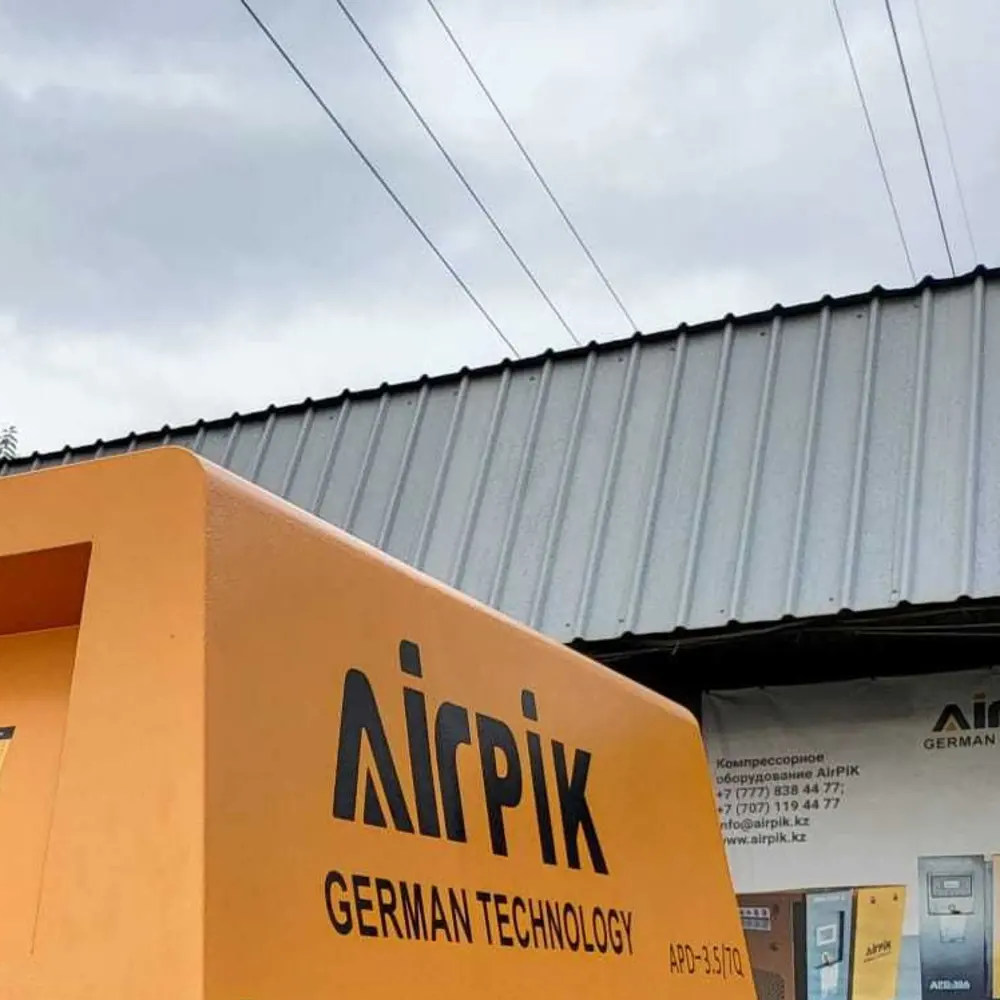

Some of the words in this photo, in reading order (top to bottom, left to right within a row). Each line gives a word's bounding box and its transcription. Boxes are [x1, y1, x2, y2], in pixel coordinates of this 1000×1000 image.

[923, 733, 996, 750] GERMAN
[717, 754, 824, 769] Компрессорное
[716, 769, 813, 785] оборудование
[736, 786, 770, 800] (777)
[774, 784, 799, 796] 838
[803, 783, 819, 794] 44
[736, 801, 770, 816] (707)
[775, 800, 799, 812] 119
[803, 799, 819, 810] 44
[823, 798, 840, 810] 77
[720, 816, 810, 832] nfo@airpik.kz
[724, 832, 807, 846] ww.airpik.kz
[325, 870, 473, 944] GERMAN
[476, 891, 634, 956] TECHNOLOGY
[669, 943, 745, 979] APD-3.5/7Q
